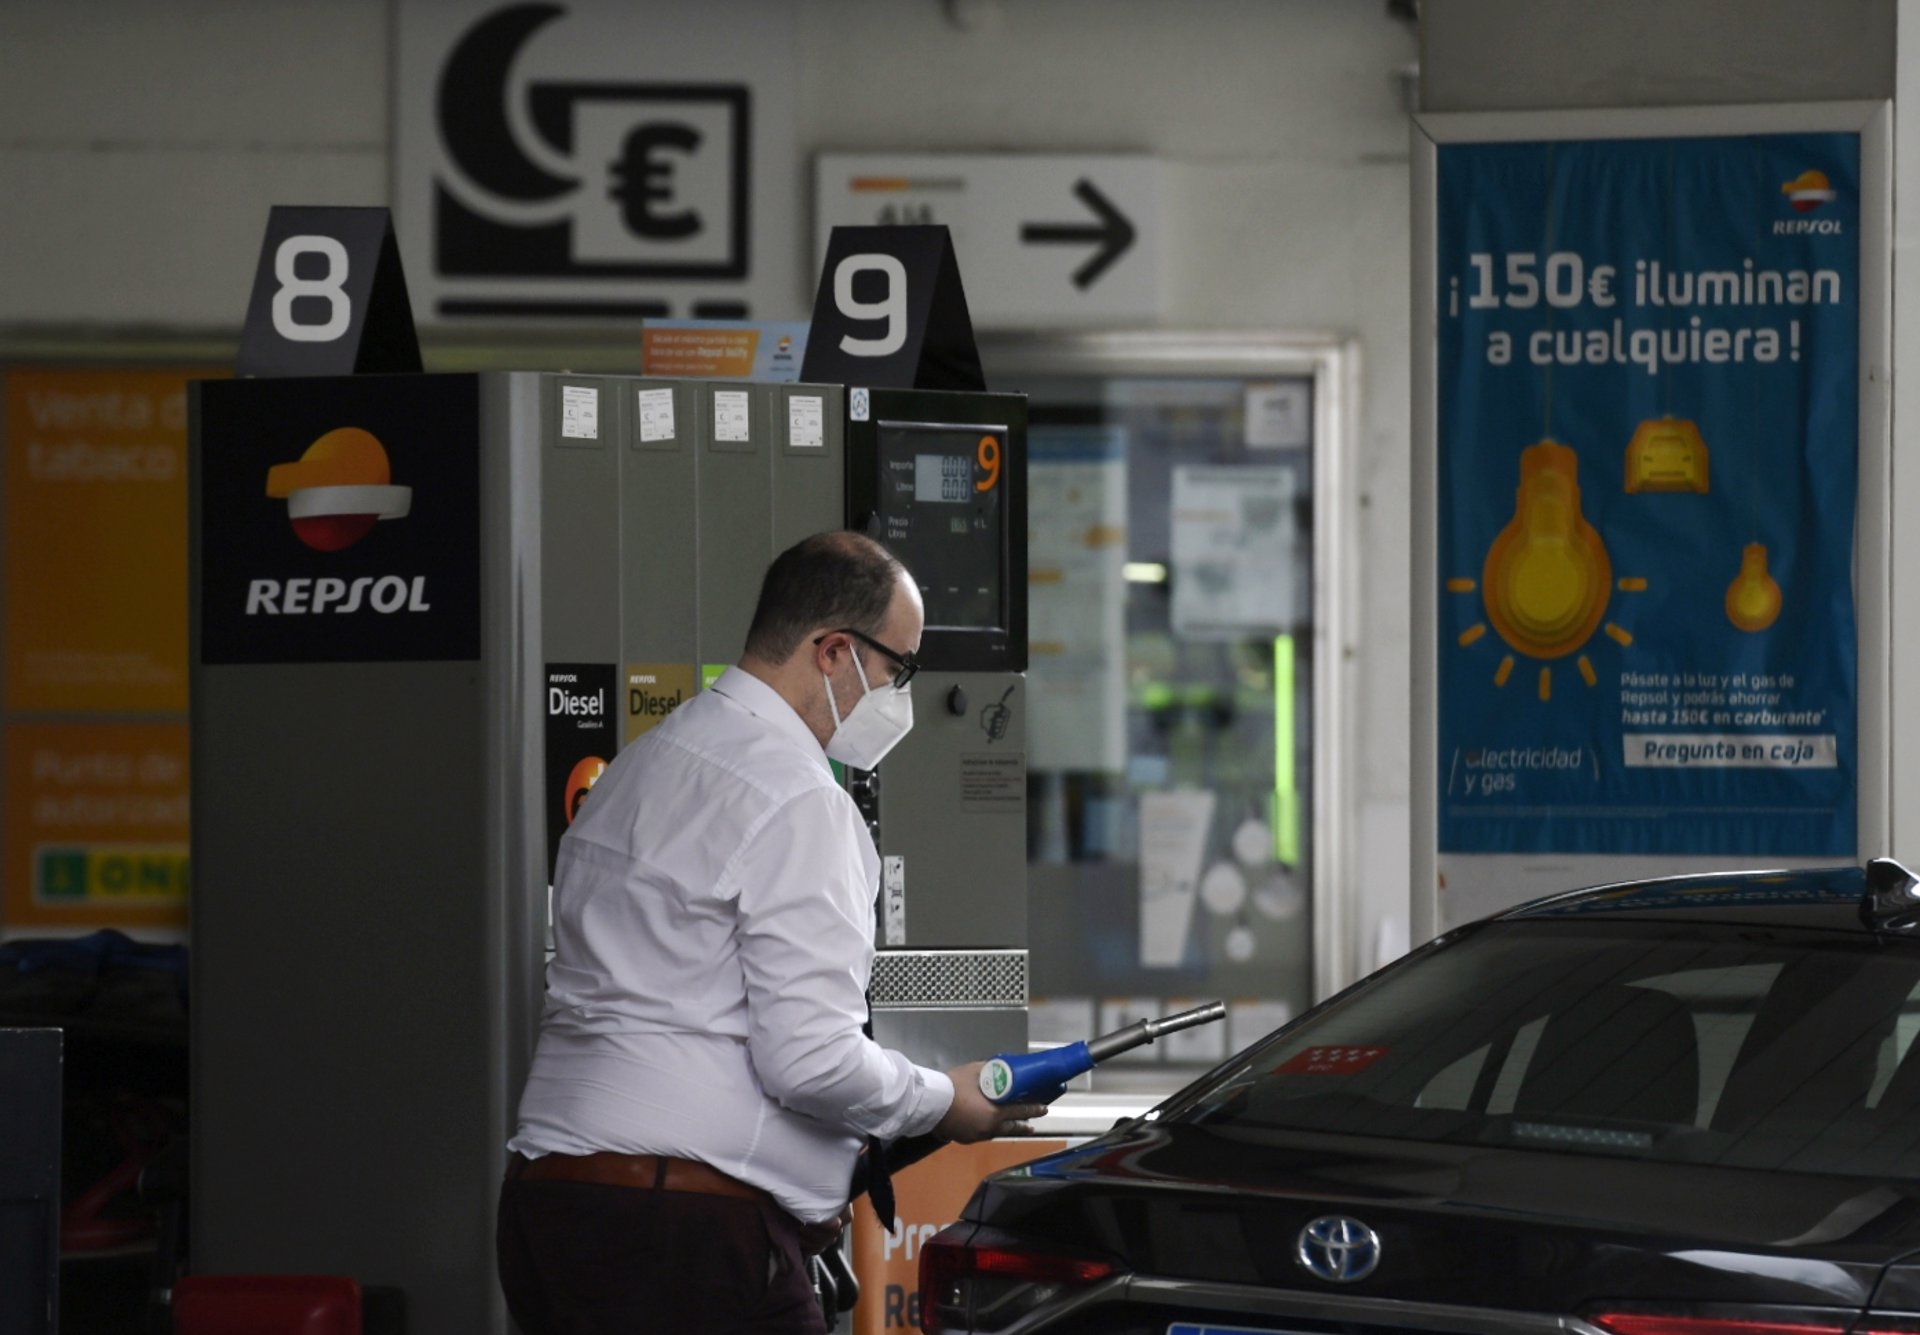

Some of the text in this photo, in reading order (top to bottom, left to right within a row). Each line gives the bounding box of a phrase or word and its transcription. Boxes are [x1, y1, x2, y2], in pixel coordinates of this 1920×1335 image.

[1773, 219, 1842, 235] REPSOL
[271, 234, 351, 343] 8
[1635, 258, 1840, 307] iluminan
[832, 252, 908, 357] 9
[1487, 331, 1512, 366] a
[976, 436, 1001, 492] 9
[245, 575, 431, 616] REPSOL
[549, 674, 578, 683] REPSOL
[629, 675, 657, 684] REPSOL
[1621, 672, 1794, 690] Pásate a la luz y el gas de
[549, 687, 605, 716] Diesel
[630, 689, 682, 716] Diesel
[1621, 691, 1781, 707] Repsol y podrás ahorrar
[1622, 710, 1667, 725] hasta
[1672, 710, 1709, 725] 150€
[1713, 713, 1730, 725] en
[1466, 746, 1582, 769] electricidad
[1644, 741, 1814, 764] Pregunta en caja
[1465, 773, 1516, 797] y gas
